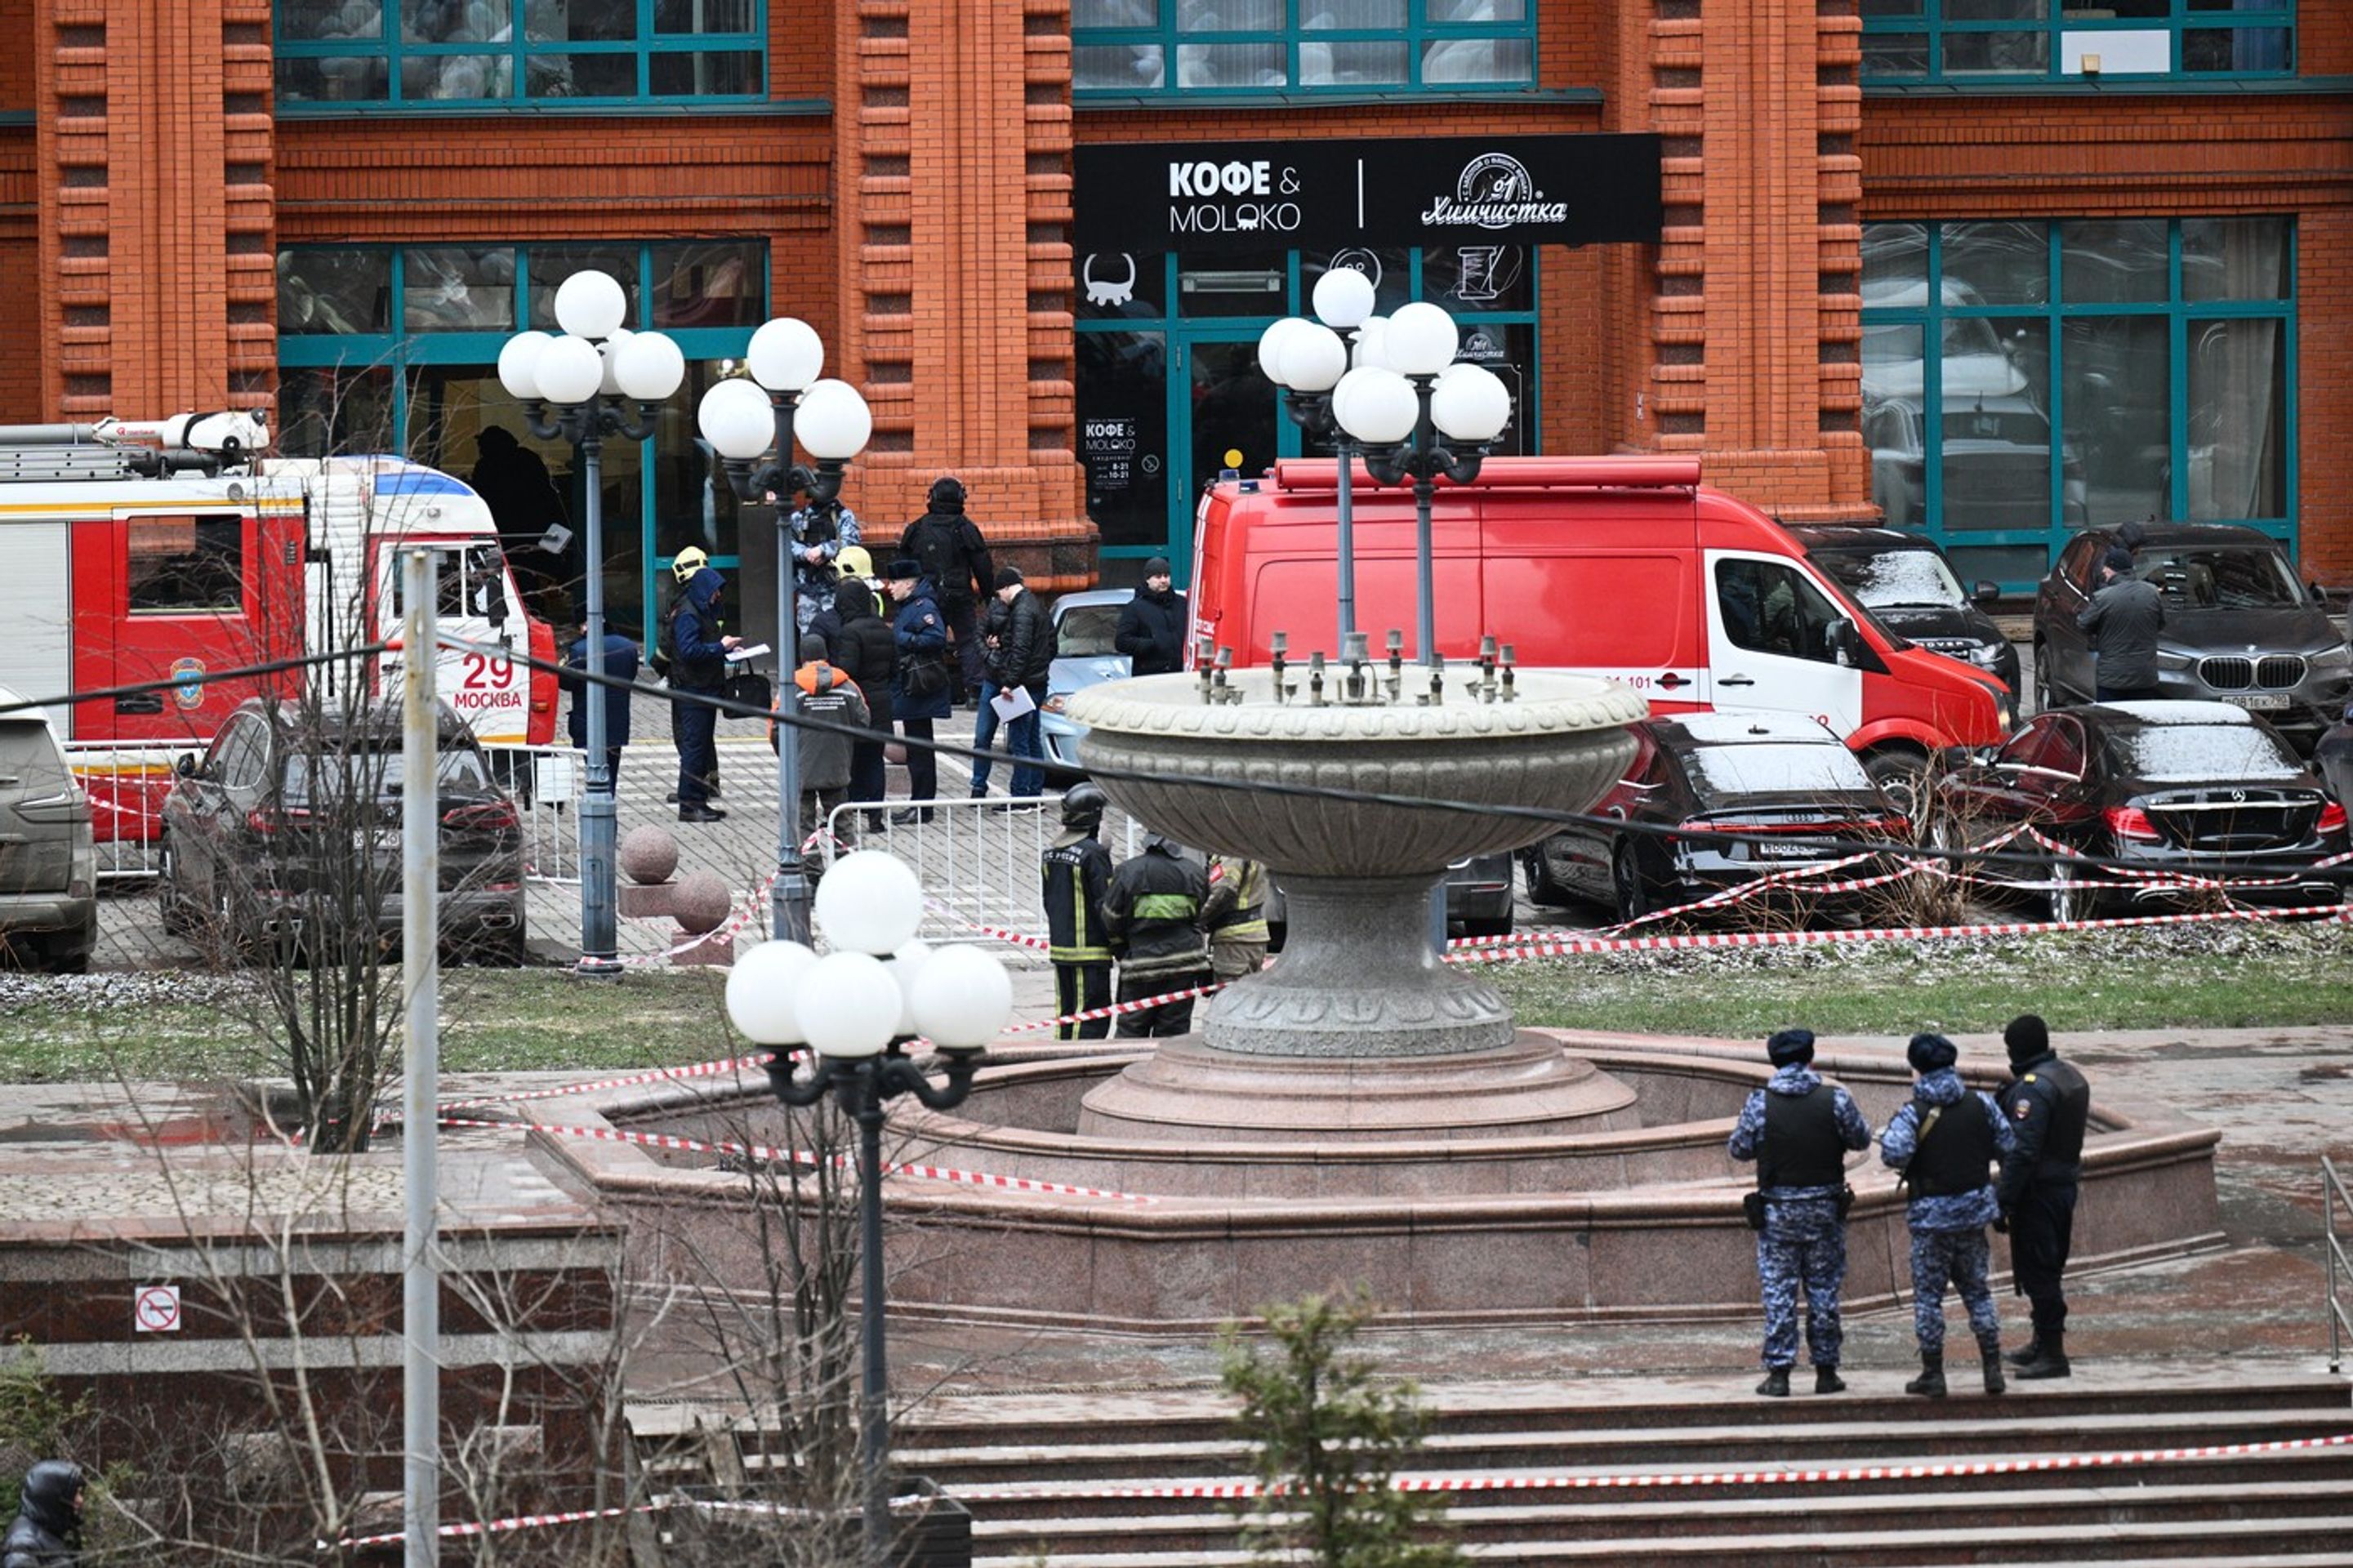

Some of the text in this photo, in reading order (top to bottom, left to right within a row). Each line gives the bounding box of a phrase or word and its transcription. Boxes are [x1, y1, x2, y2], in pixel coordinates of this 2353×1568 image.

[1170, 161, 1301, 197] КОФЕ &
[1421, 196, 1568, 225] Химчистка
[1085, 423, 1124, 437] КОФЕ
[463, 652, 513, 689] 29
[1629, 676, 1650, 688] 101
[454, 693, 522, 709] МОСКВА
